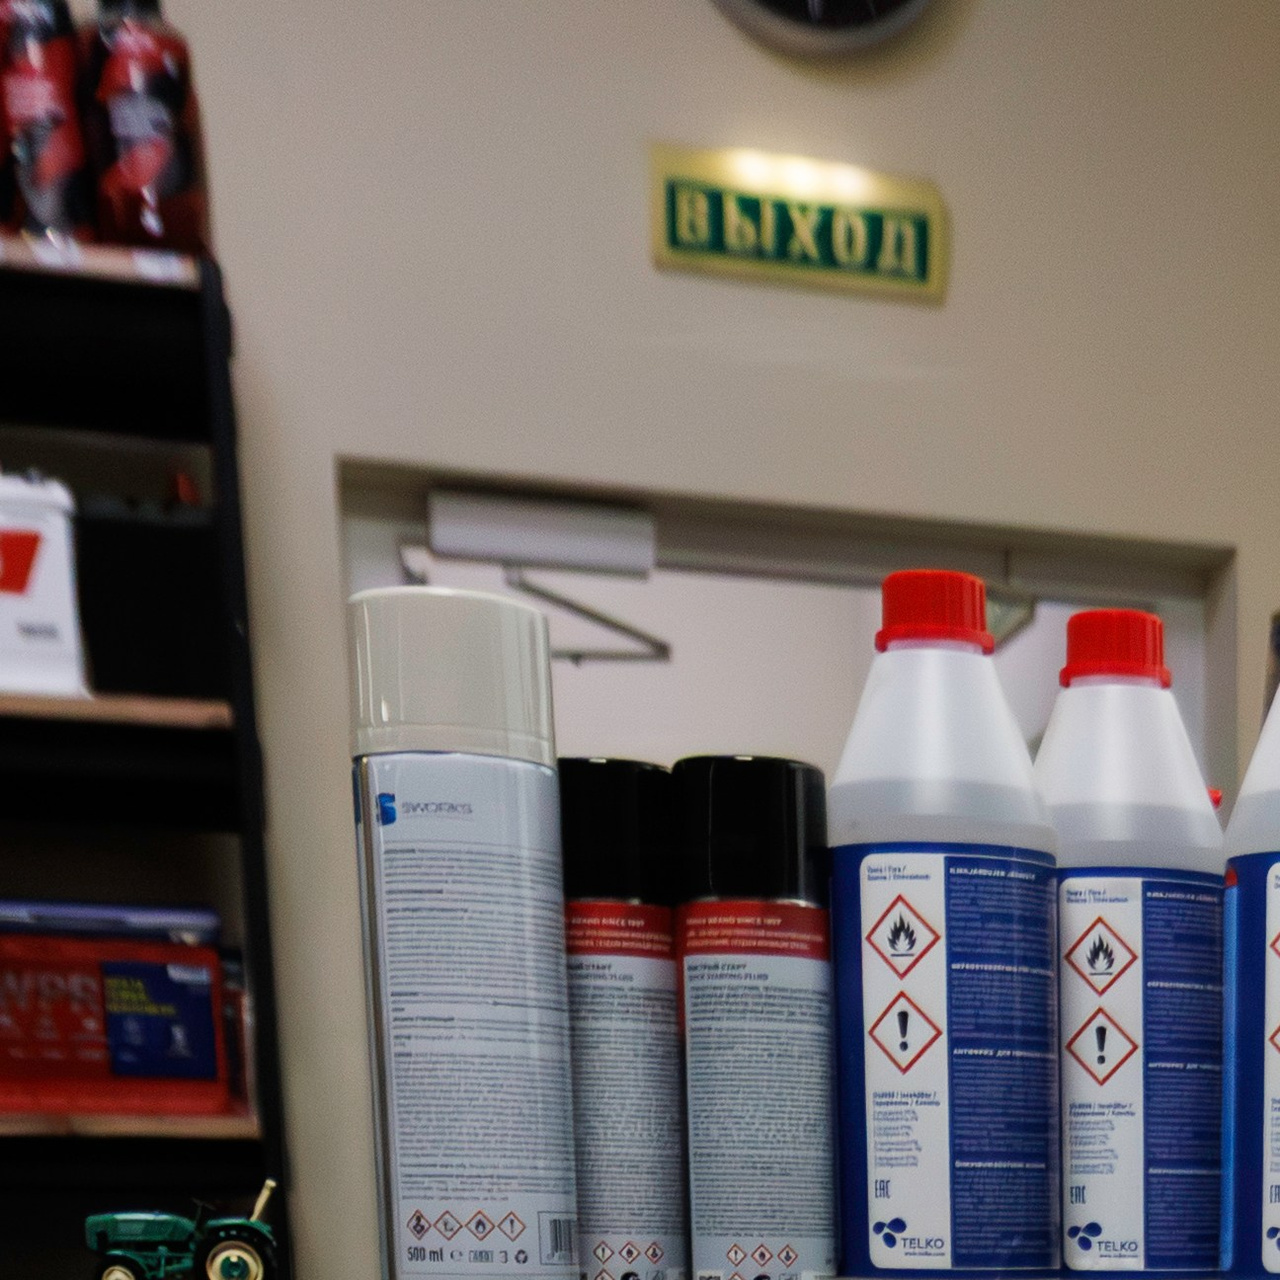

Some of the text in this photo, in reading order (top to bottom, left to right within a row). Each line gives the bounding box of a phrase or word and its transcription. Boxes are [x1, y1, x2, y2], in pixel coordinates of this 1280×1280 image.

[675, 190, 917, 273] ВЫХОД
[901, 1237, 945, 1250] TELKO
[1097, 1241, 1139, 1252] TELKO
[407, 1247, 426, 1263] 500
